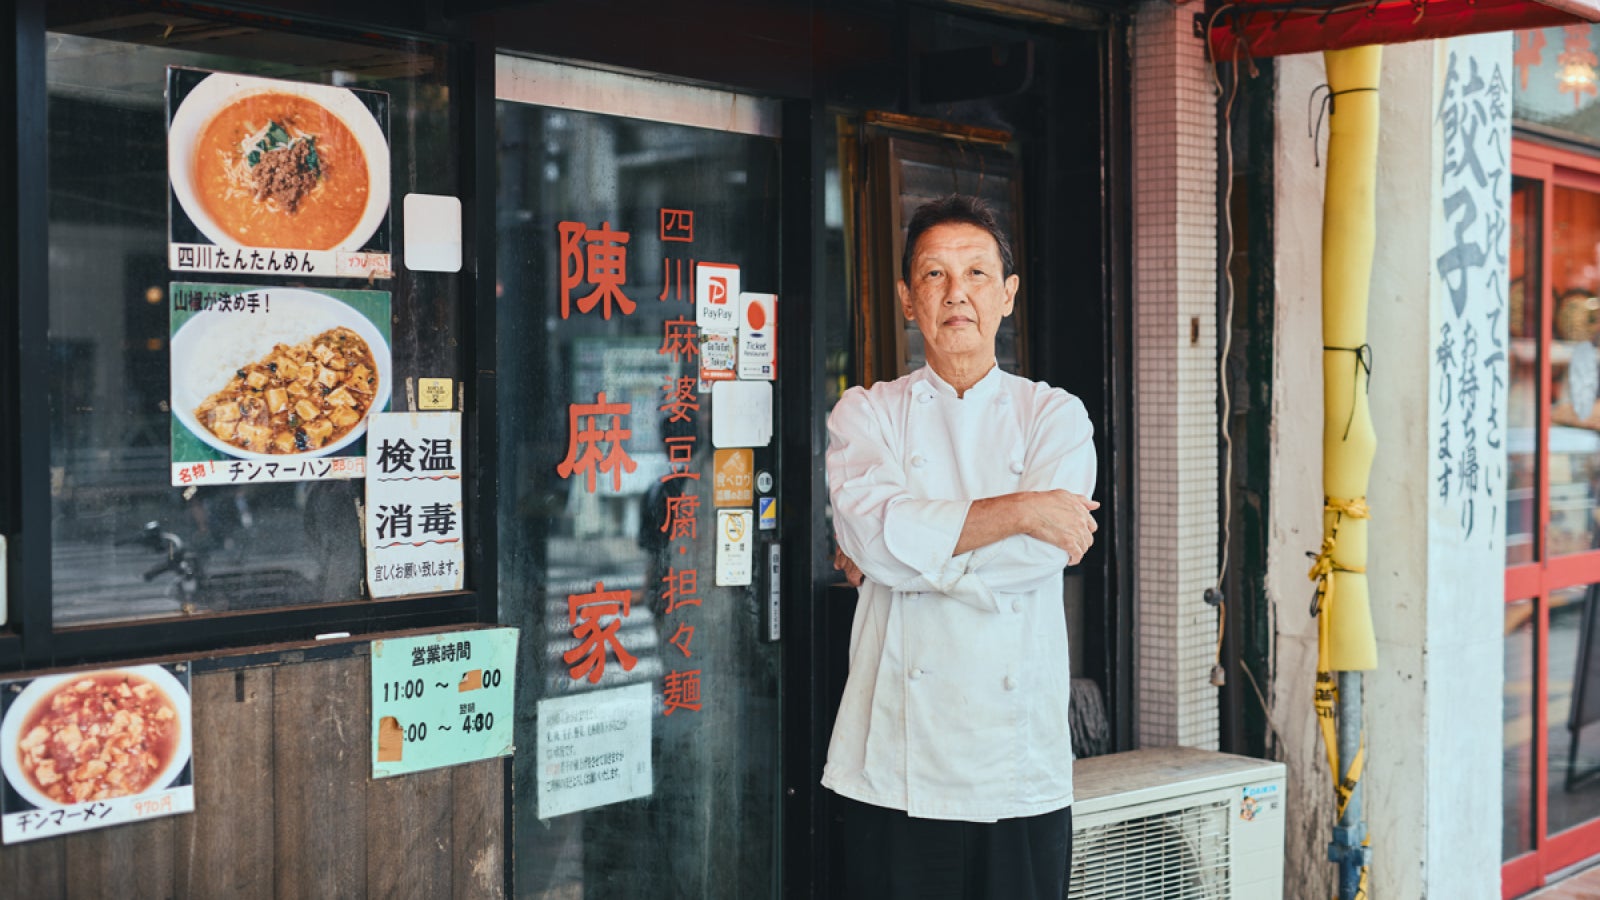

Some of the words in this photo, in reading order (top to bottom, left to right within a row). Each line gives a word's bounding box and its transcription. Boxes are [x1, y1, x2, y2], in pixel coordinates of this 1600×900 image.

[1434, 51, 1488, 319] 餃子
[177, 246, 315, 273] 四川たんたんめん
[703, 307, 732, 320] PayPay
[746, 341, 767, 351] Ticket
[1437, 321, 1457, 504] 承ります
[1458, 320, 1480, 541] お持ち帰り
[376, 437, 456, 474] 検温
[557, 220, 637, 685] 陳麻家
[229, 459, 332, 482] チンマーハン
[375, 502, 457, 540] 消毒
[411, 641, 471, 667] 営業時間
[383, 678, 424, 702] 11:00
[16, 802, 113, 832] チンマーメン
